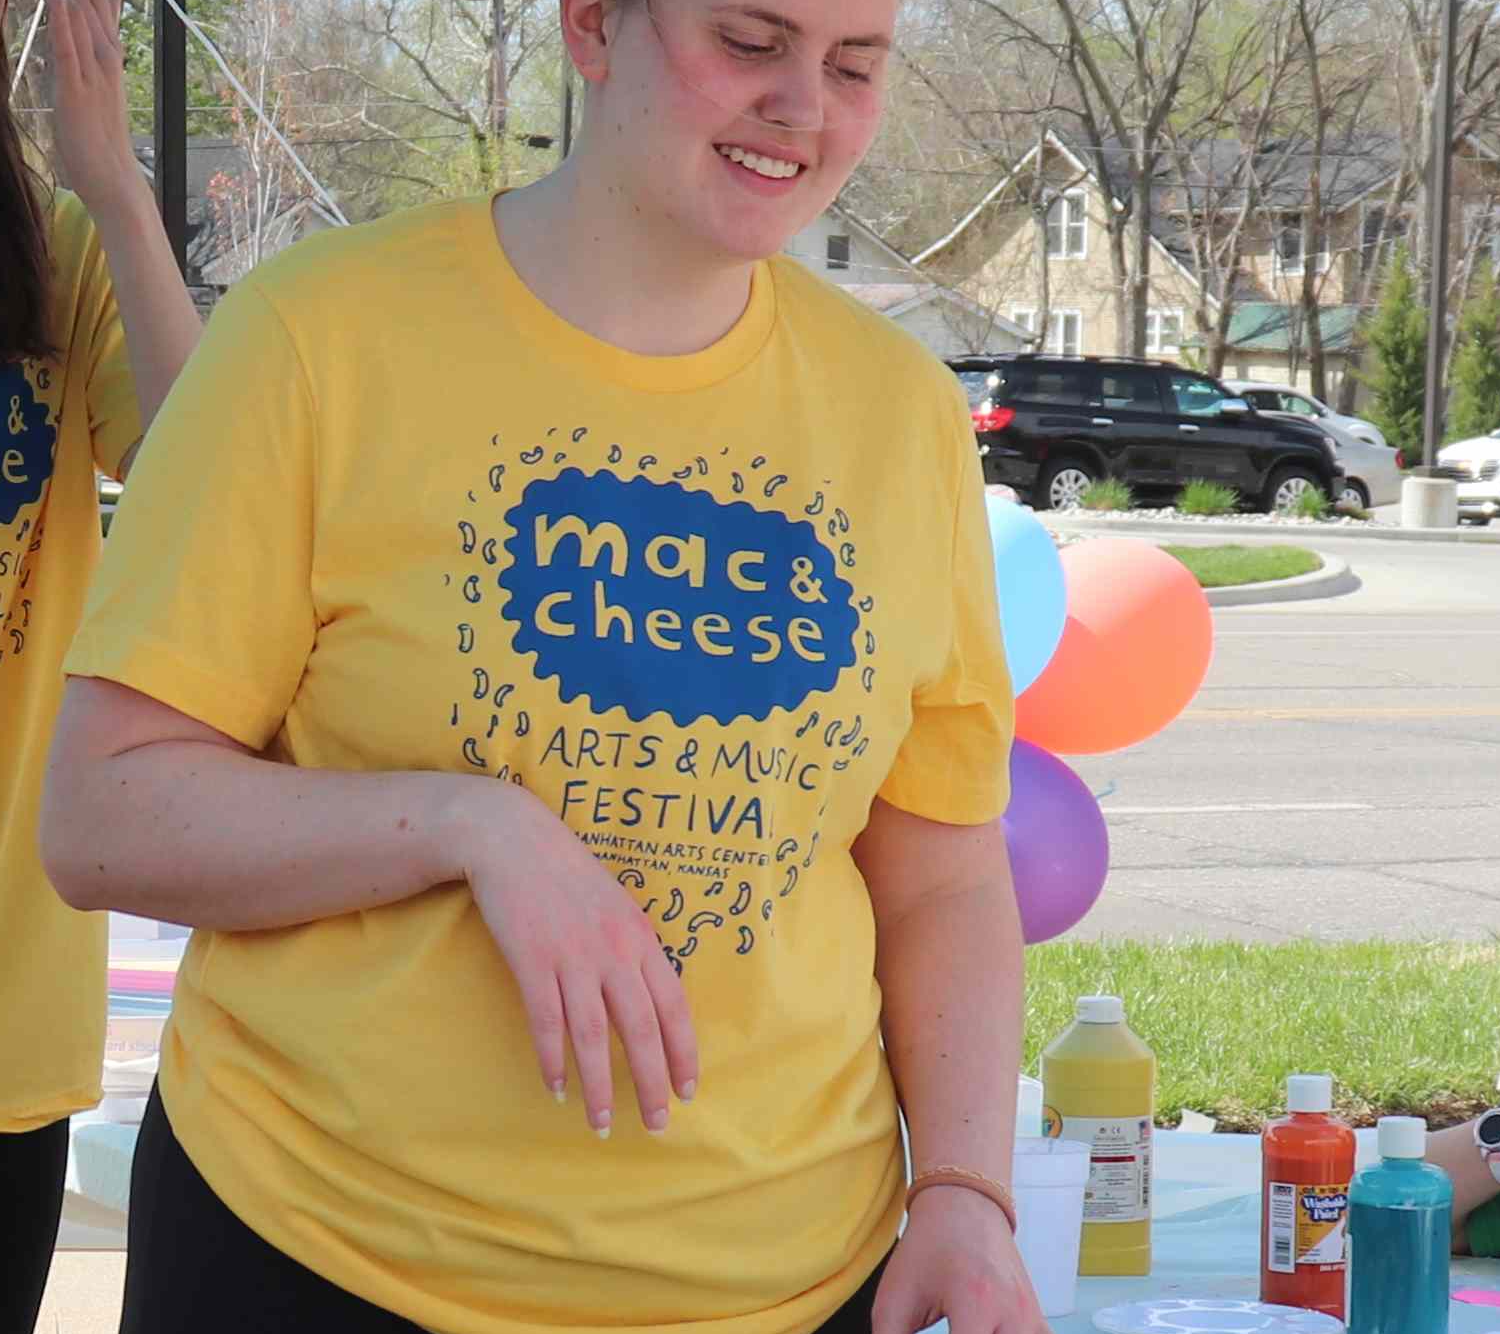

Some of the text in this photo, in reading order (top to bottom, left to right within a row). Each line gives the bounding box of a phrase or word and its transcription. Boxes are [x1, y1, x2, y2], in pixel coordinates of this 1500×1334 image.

[8, 397, 28, 435] &
[535, 514, 828, 604] mac &
[534, 579, 827, 663] cheese
[540, 726, 823, 791] ARTS & MUSIC
[560, 781, 774, 838] FESTIVA
[664, 844, 707, 860] ARTS
[712, 847, 770, 866] CENTE
[678, 864, 730, 879] KANSAS
